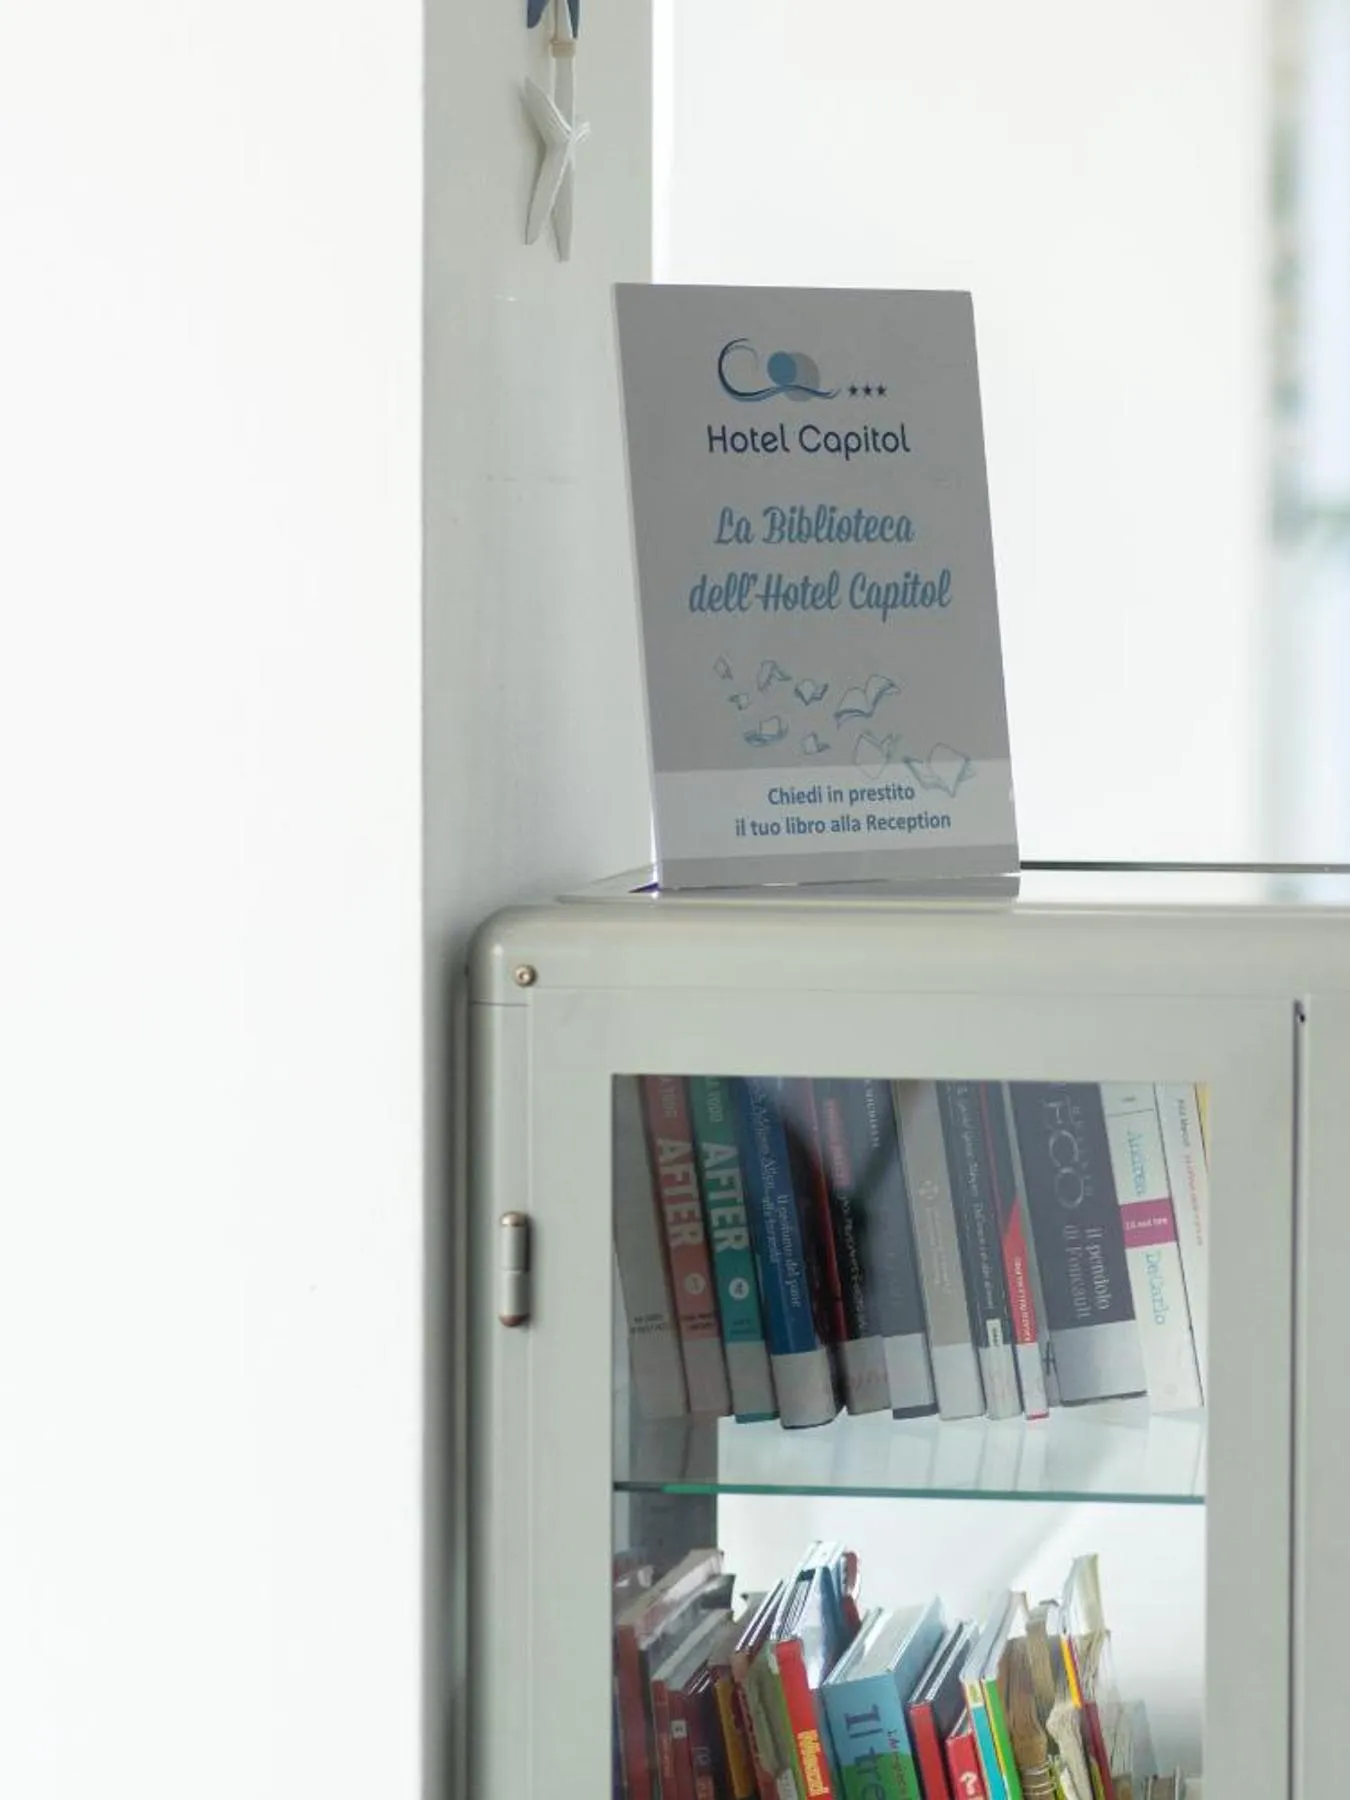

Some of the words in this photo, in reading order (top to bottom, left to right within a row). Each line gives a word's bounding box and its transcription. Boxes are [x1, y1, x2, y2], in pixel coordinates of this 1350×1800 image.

[707, 423, 790, 453] Hotel
[799, 422, 911, 461] Capitol
[714, 506, 754, 544] La
[762, 503, 915, 544] Biblioteca
[689, 569, 840, 614] dell'Hotel
[849, 569, 952, 623] Capitol
[768, 785, 822, 806] Chiedi
[828, 785, 844, 802] in
[849, 783, 915, 806] prestito
[735, 818, 746, 836] il
[751, 820, 781, 836] tuo
[786, 816, 826, 834] libro
[831, 815, 861, 833] alla
[867, 811, 951, 834] Reception
[656, 1138, 704, 1247] AFTER
[702, 1142, 750, 1253] AFTER
[1085, 1227, 1104, 1239] Il
[1085, 1243, 1112, 1311] pendolo
[846, 1704, 884, 1739] Il
